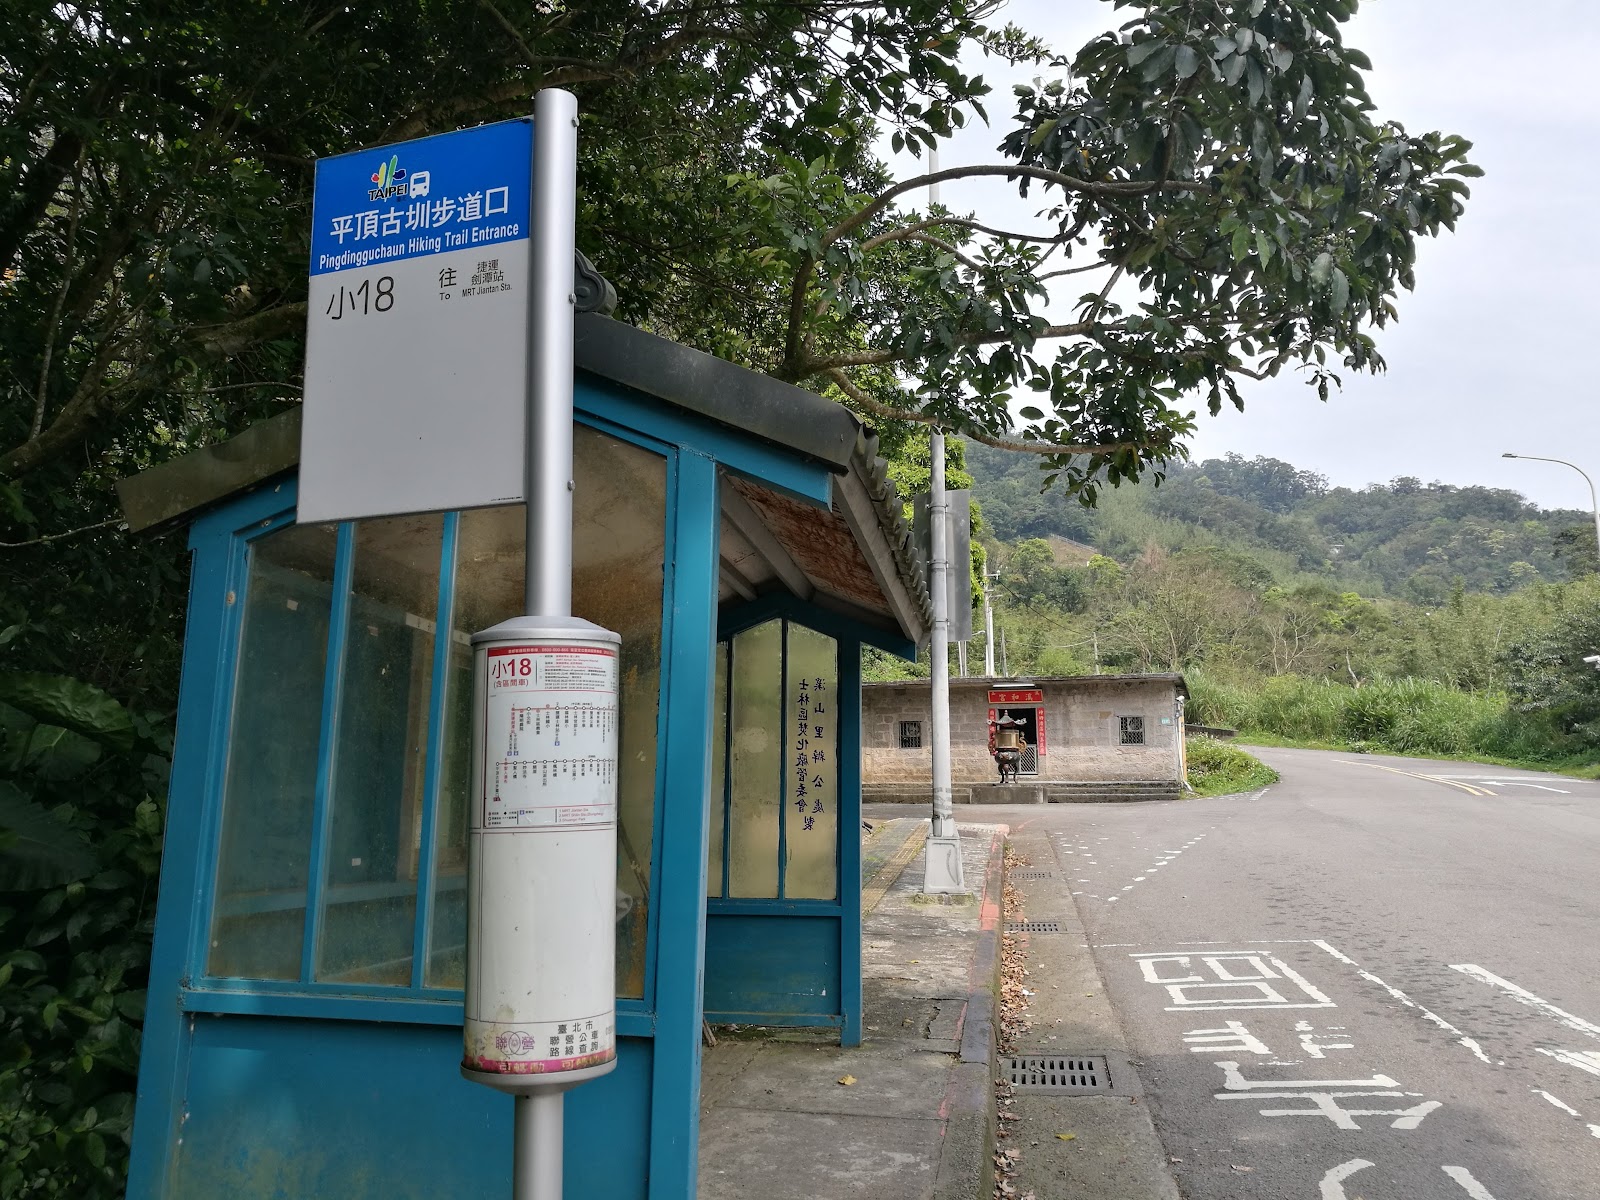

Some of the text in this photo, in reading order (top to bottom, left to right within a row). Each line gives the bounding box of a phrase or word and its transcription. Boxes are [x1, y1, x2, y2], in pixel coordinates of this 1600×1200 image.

[368, 183, 408, 202] TAIPEI
[329, 186, 509, 244] 平頂古圳步道口
[319, 223, 519, 270] Pingdingguchaun Hiking Trail Entrance
[477, 259, 499, 273] 捷運
[438, 267, 457, 289] 往
[326, 276, 395, 320] 小18
[440, 292, 451, 300] To
[462, 282, 512, 298] MRT Jiantan Sta.
[491, 658, 532, 679] 小18
[557, 1020, 594, 1034] 臺北市
[549, 1030, 599, 1046] 聯營公車
[549, 1041, 599, 1057] 路線查詢
